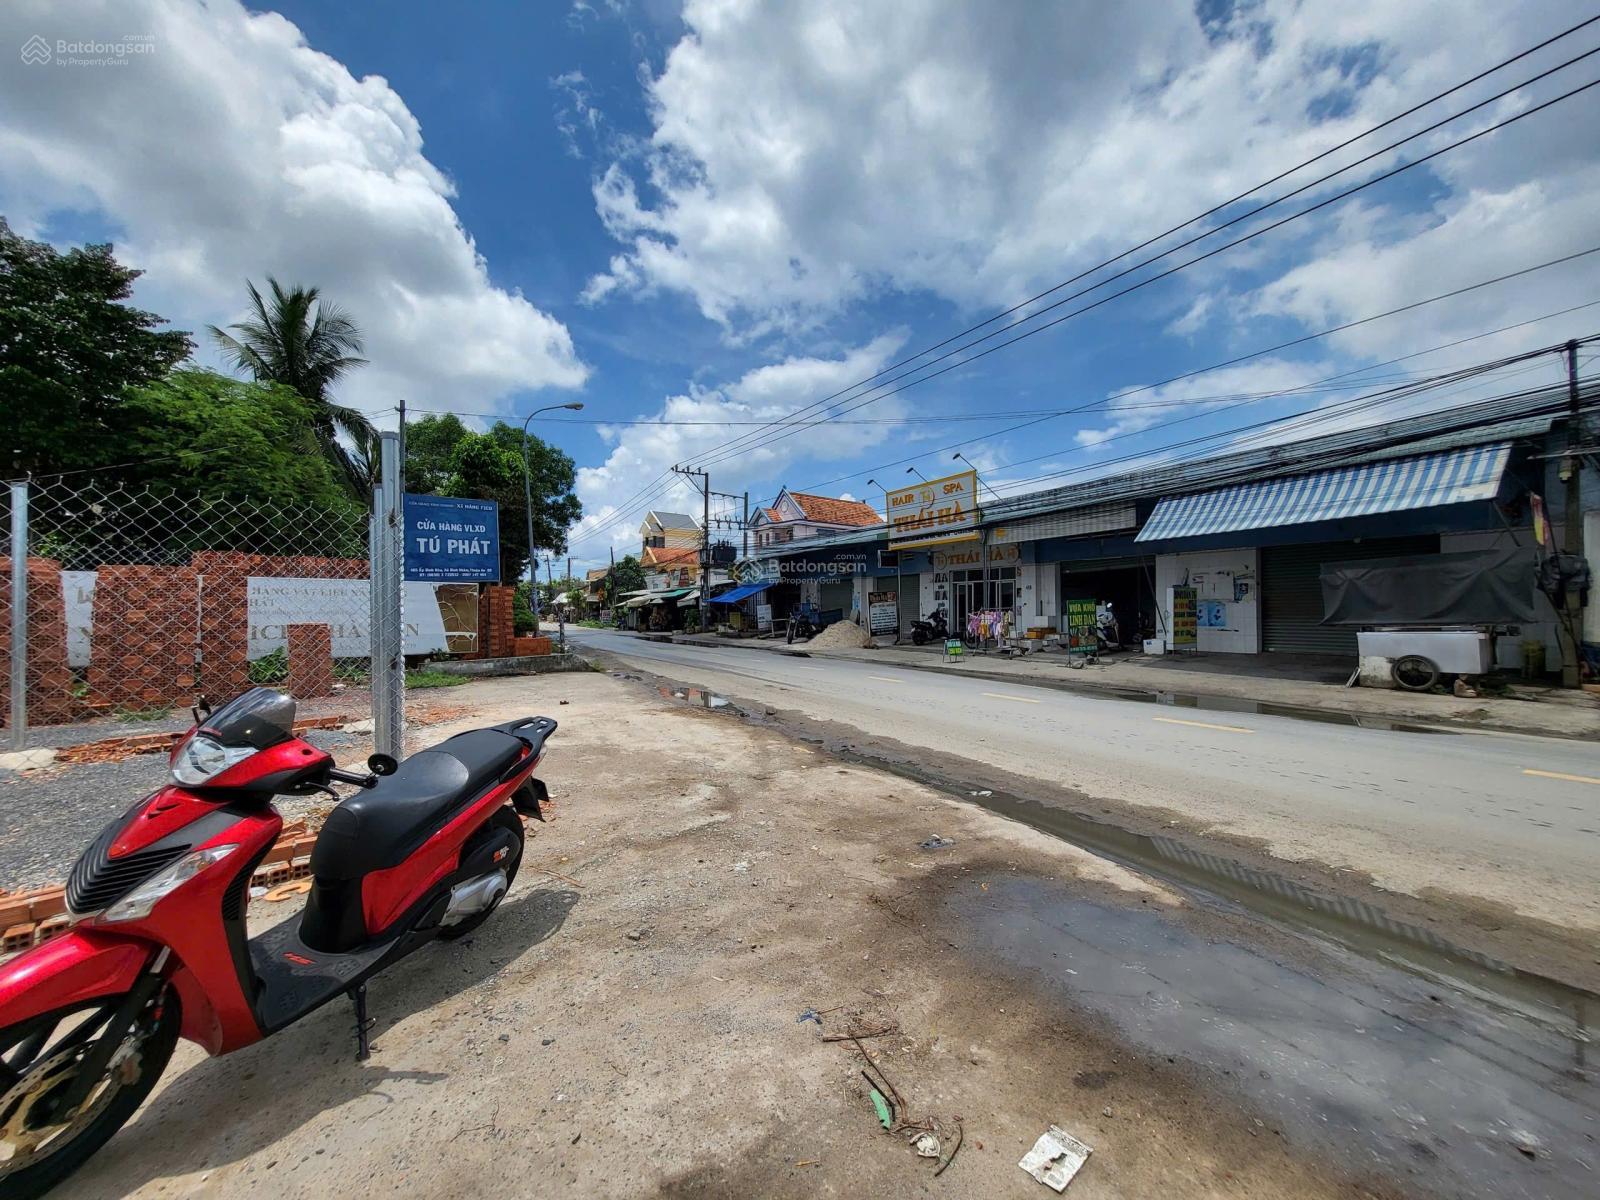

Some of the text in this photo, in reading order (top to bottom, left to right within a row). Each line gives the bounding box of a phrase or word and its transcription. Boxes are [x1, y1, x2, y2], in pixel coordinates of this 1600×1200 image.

[892, 493, 914, 507] HAIR
[943, 482, 963, 495] SPA
[416, 518, 437, 531] CỬA
[438, 520, 462, 532] HÀNG
[416, 535, 491, 555] TÚ PHÁT
